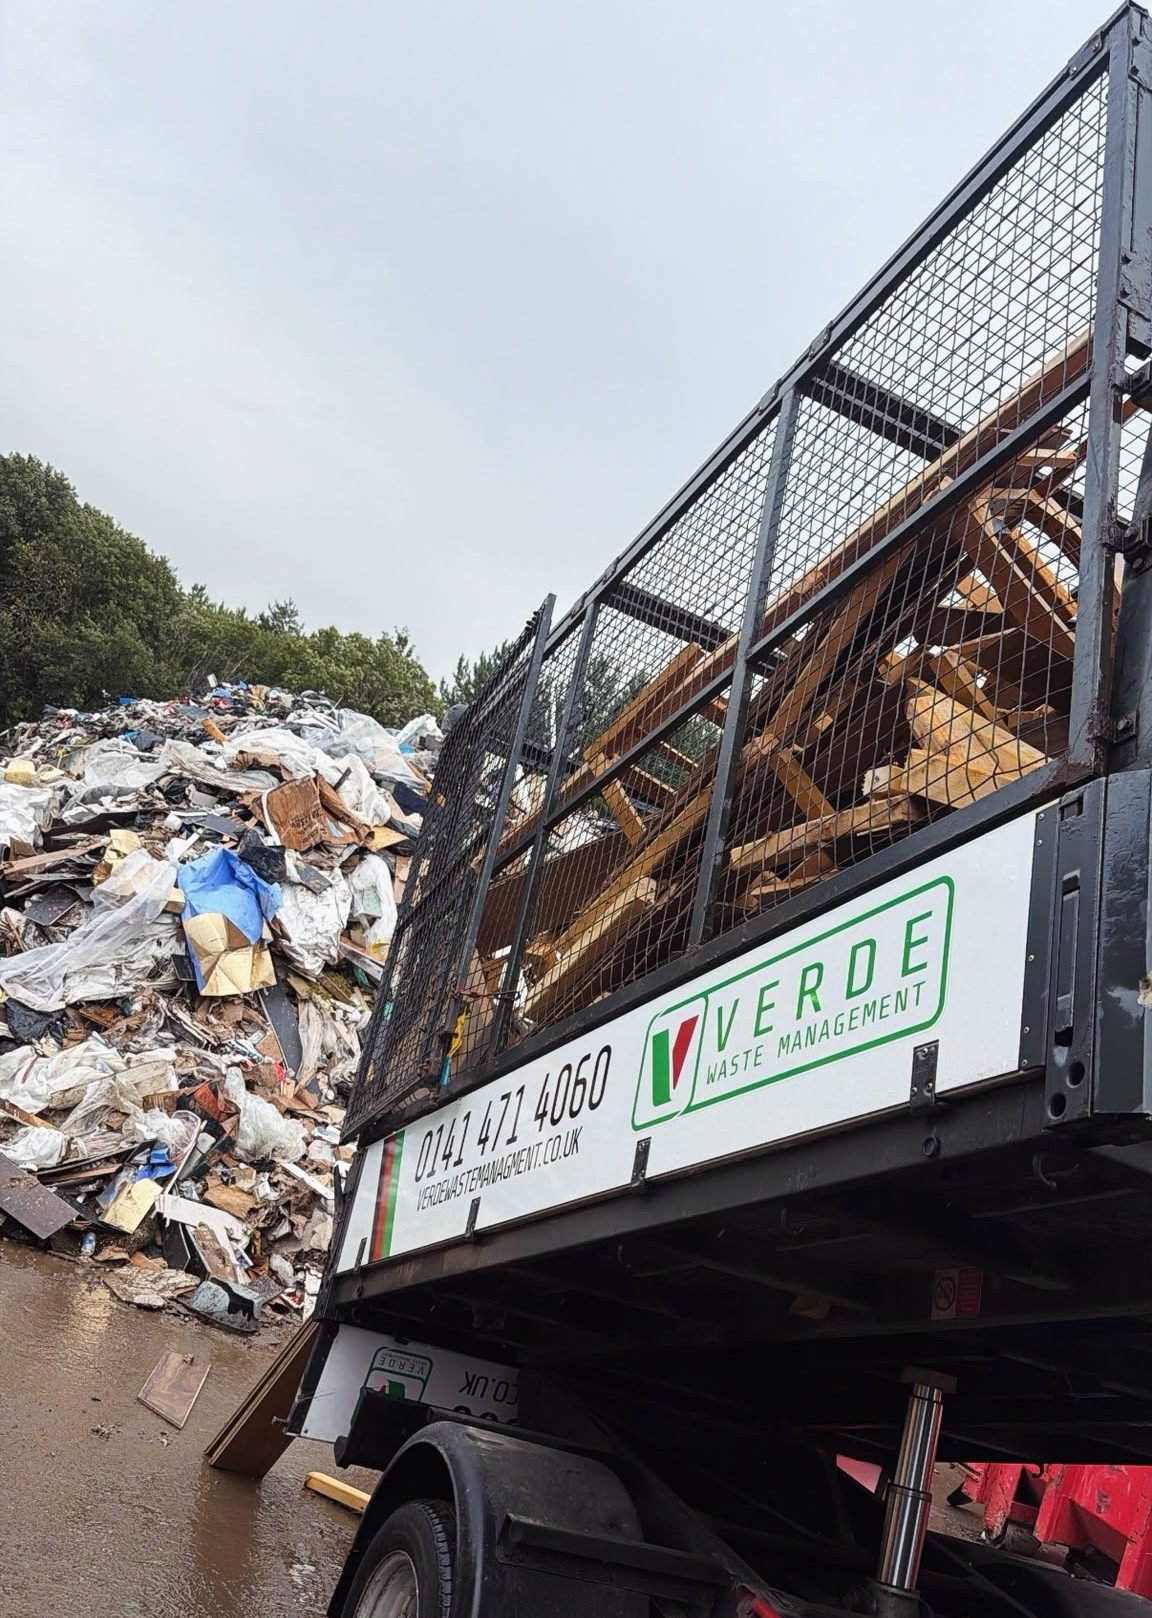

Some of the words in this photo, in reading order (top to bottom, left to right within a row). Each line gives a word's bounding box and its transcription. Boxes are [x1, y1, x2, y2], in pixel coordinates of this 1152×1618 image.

[706, 1045, 764, 1085] WASTE
[777, 980, 926, 1058] MANAGEMENT
[717, 910, 933, 1052] VERDE
[414, 1110, 471, 1183] 0141
[477, 1084, 526, 1156] 471
[534, 1044, 612, 1133] 4060
[416, 1126, 583, 1211] VERDEWASTEMANAGMENT.CO.UK
[378, 1356, 425, 1376] VERDE
